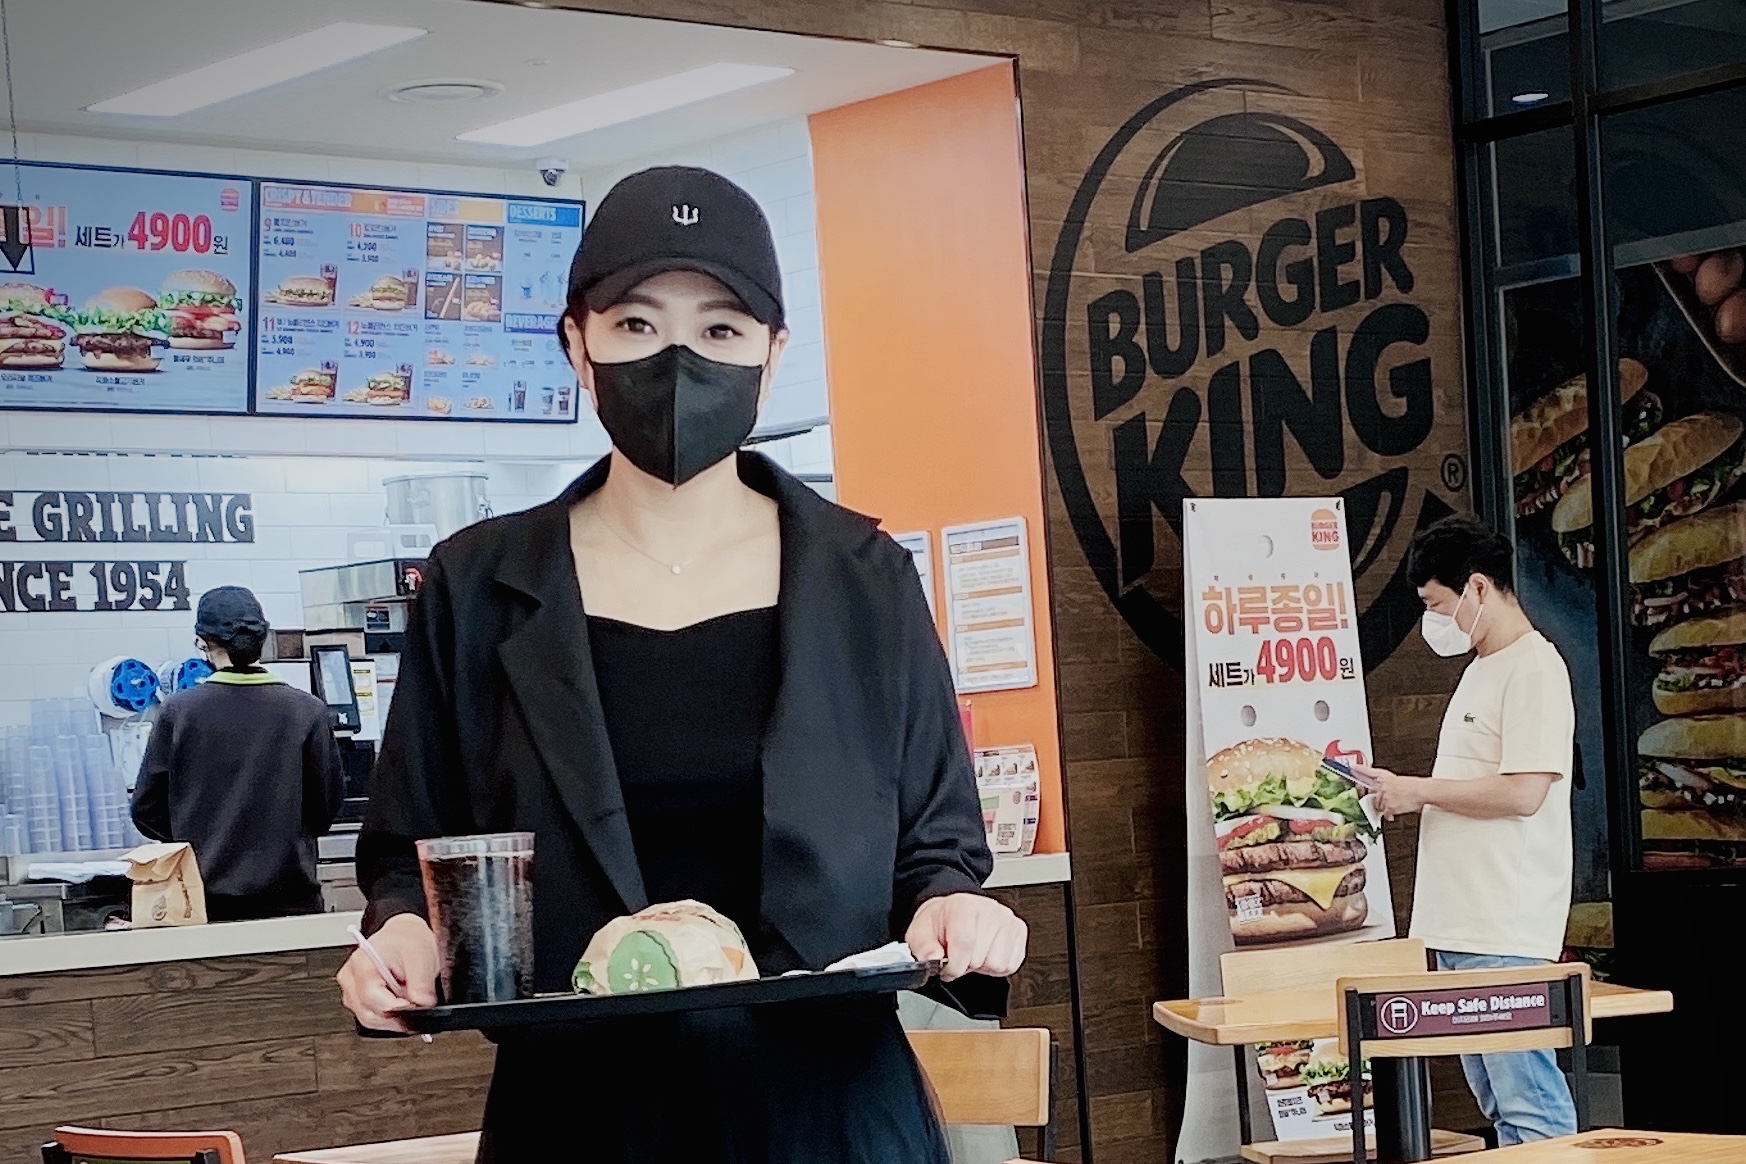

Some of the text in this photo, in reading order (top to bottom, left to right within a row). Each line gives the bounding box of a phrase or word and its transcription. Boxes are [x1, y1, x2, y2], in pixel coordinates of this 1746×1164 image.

[1087, 197, 1414, 422] BURGER
[1112, 302, 1434, 588] KING
[33, 491, 255, 543] GRILLING
[1312, 531, 1339, 543] KING
[90, 561, 191, 611] 1954
[1202, 581, 1349, 635] 하루종일!
[1421, 993, 1545, 1016] Keep Safe Distance
